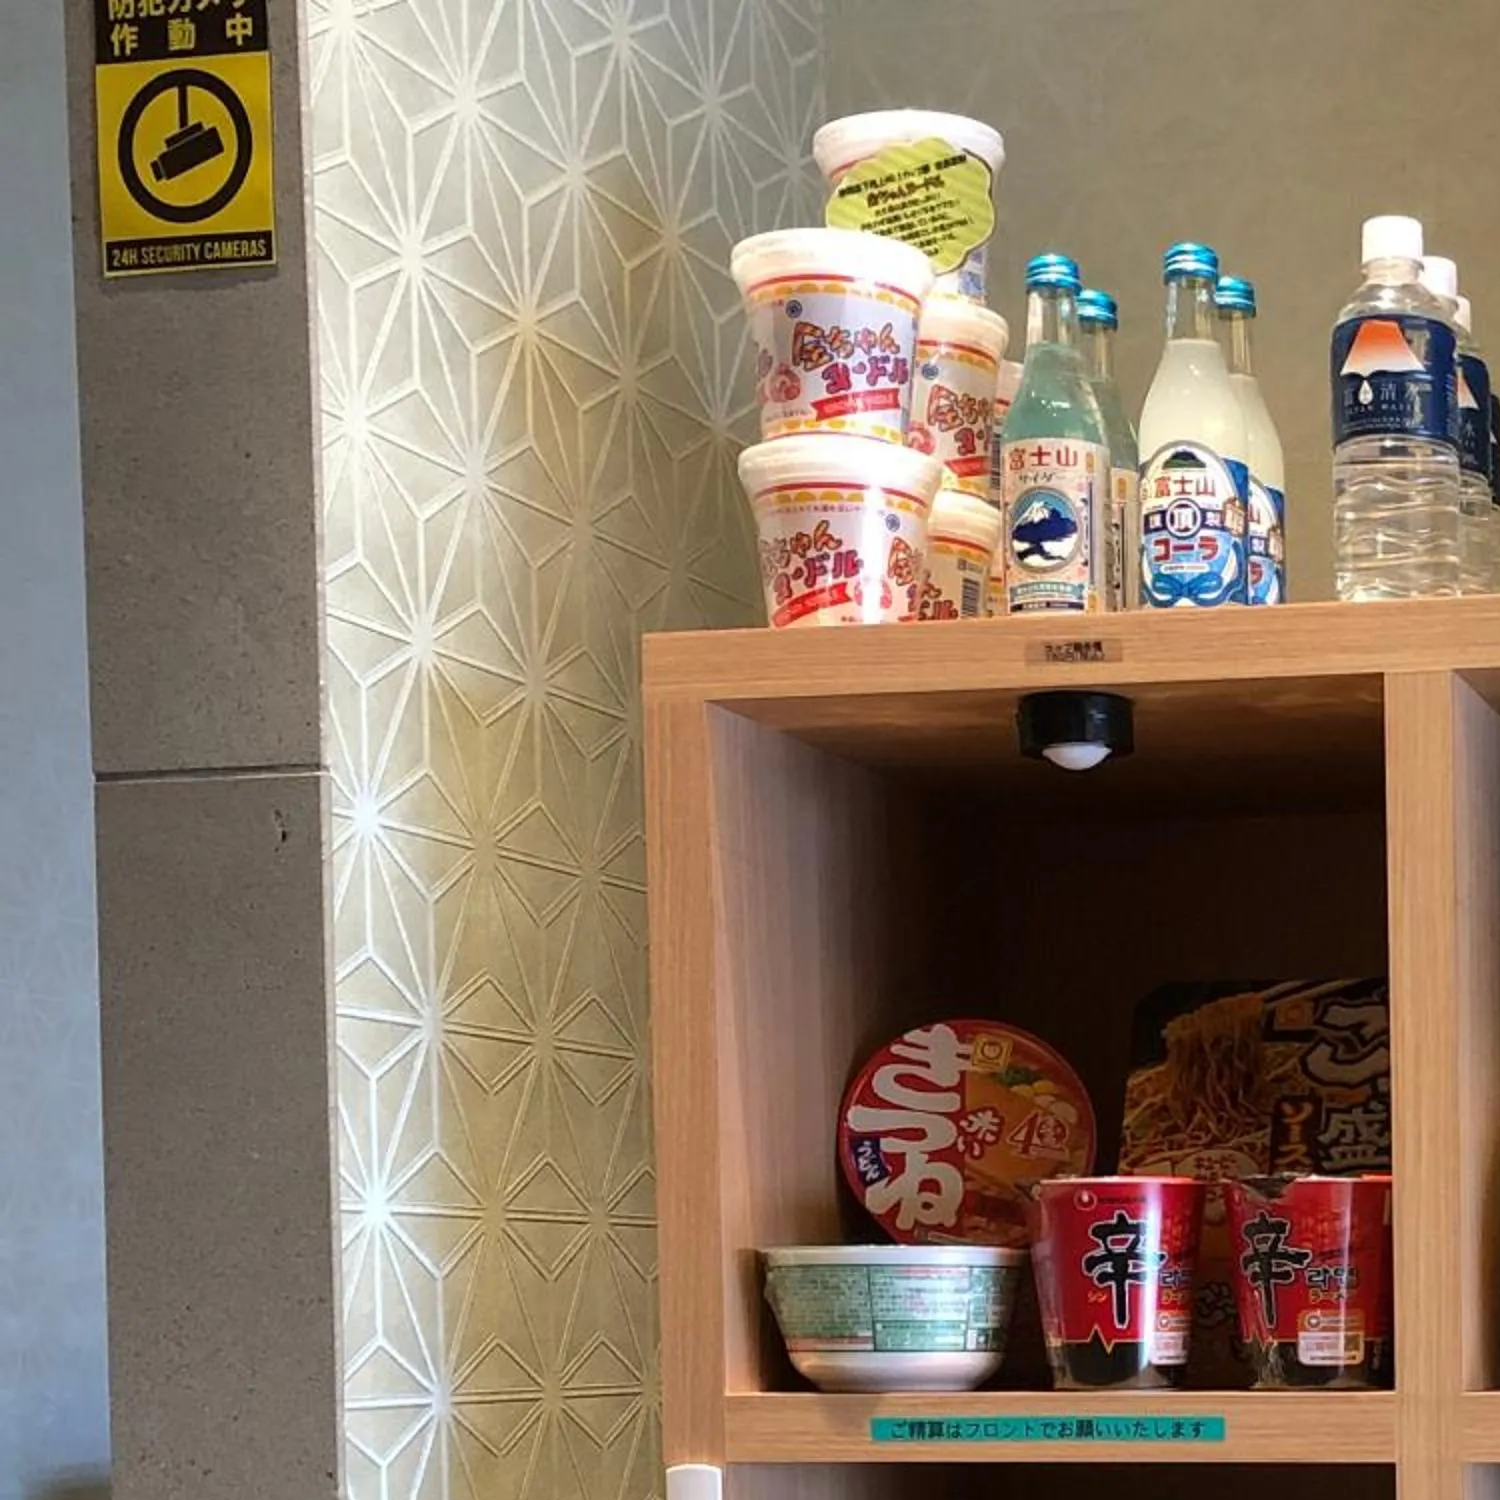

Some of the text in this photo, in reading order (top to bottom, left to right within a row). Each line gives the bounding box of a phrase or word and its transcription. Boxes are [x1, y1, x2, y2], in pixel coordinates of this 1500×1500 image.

[110, 14, 253, 57] 作動中
[112, 239, 267, 267] 24H SECURITY CAMERAS
[1009, 445, 1079, 472] 富士山
[1154, 476, 1217, 499] 富士山
[1153, 535, 1218, 562] コーラ
[847, 1023, 973, 1230] きつね
[1084, 1210, 1167, 1328] 辛
[1240, 1210, 1312, 1328] 辛
[890, 1420, 1205, 1440] ご精算はフロントでお願いいたします
